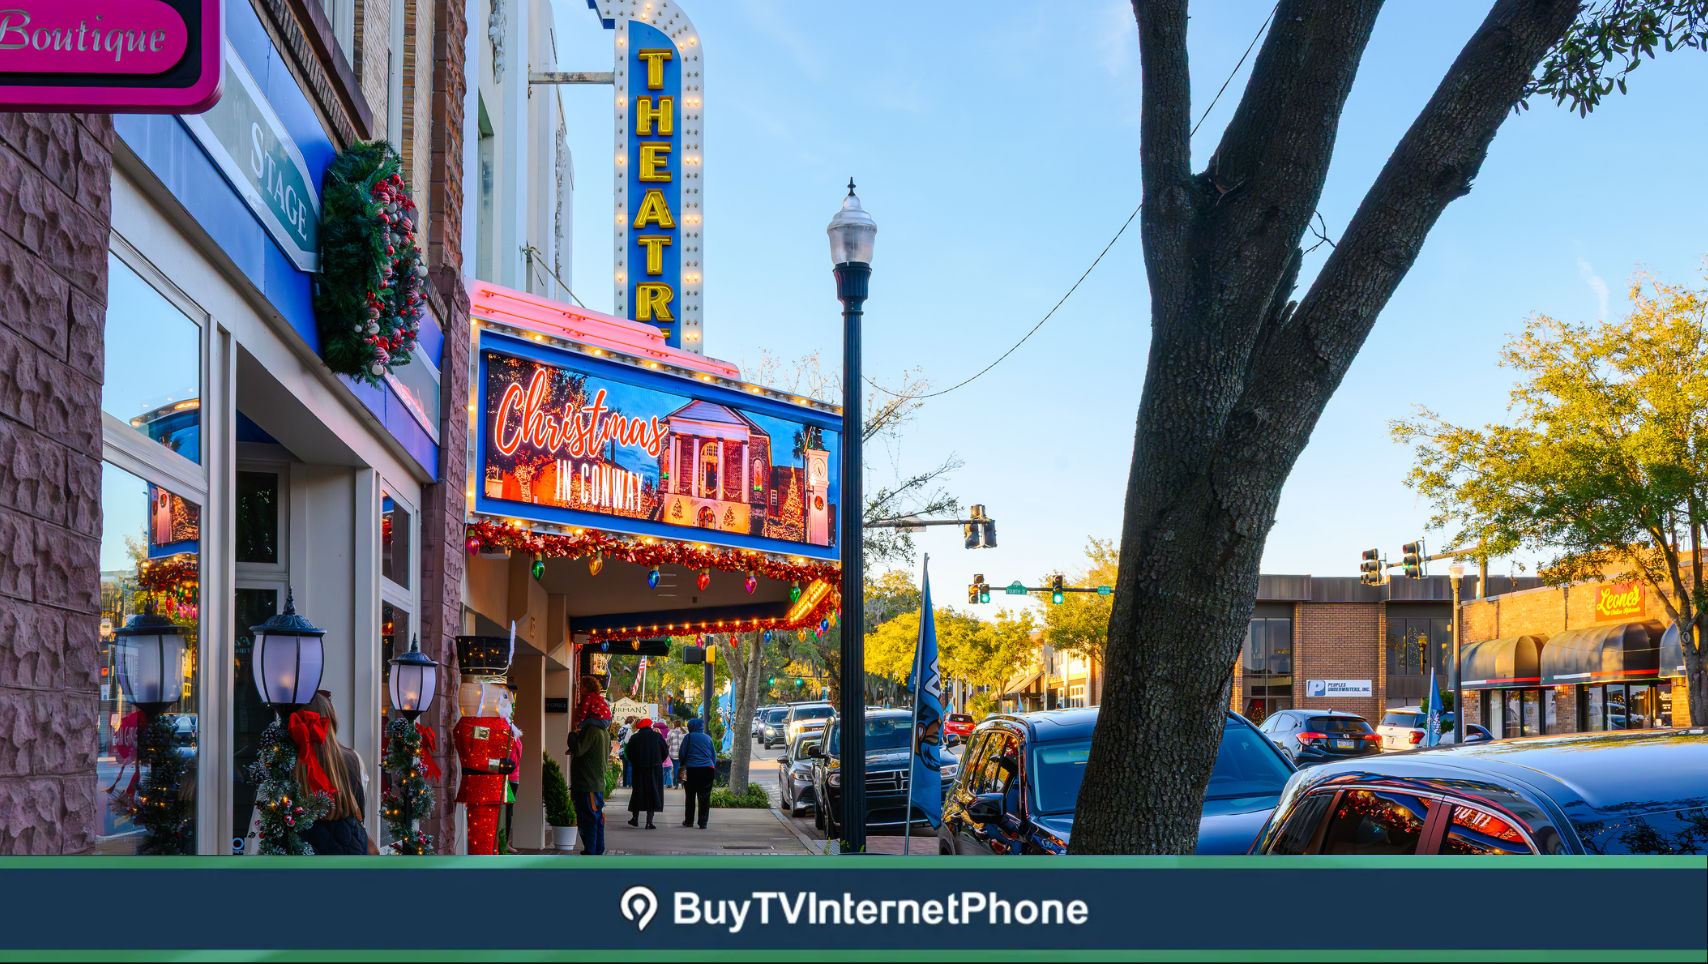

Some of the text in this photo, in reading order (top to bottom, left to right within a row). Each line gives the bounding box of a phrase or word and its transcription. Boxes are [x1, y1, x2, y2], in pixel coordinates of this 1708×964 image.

[0, 9, 166, 62] Boutique
[251, 121, 308, 241] STAGE
[633, 48, 676, 338] THEATR
[495, 368, 669, 458] Christmas
[556, 458, 643, 512] IN CONWAY
